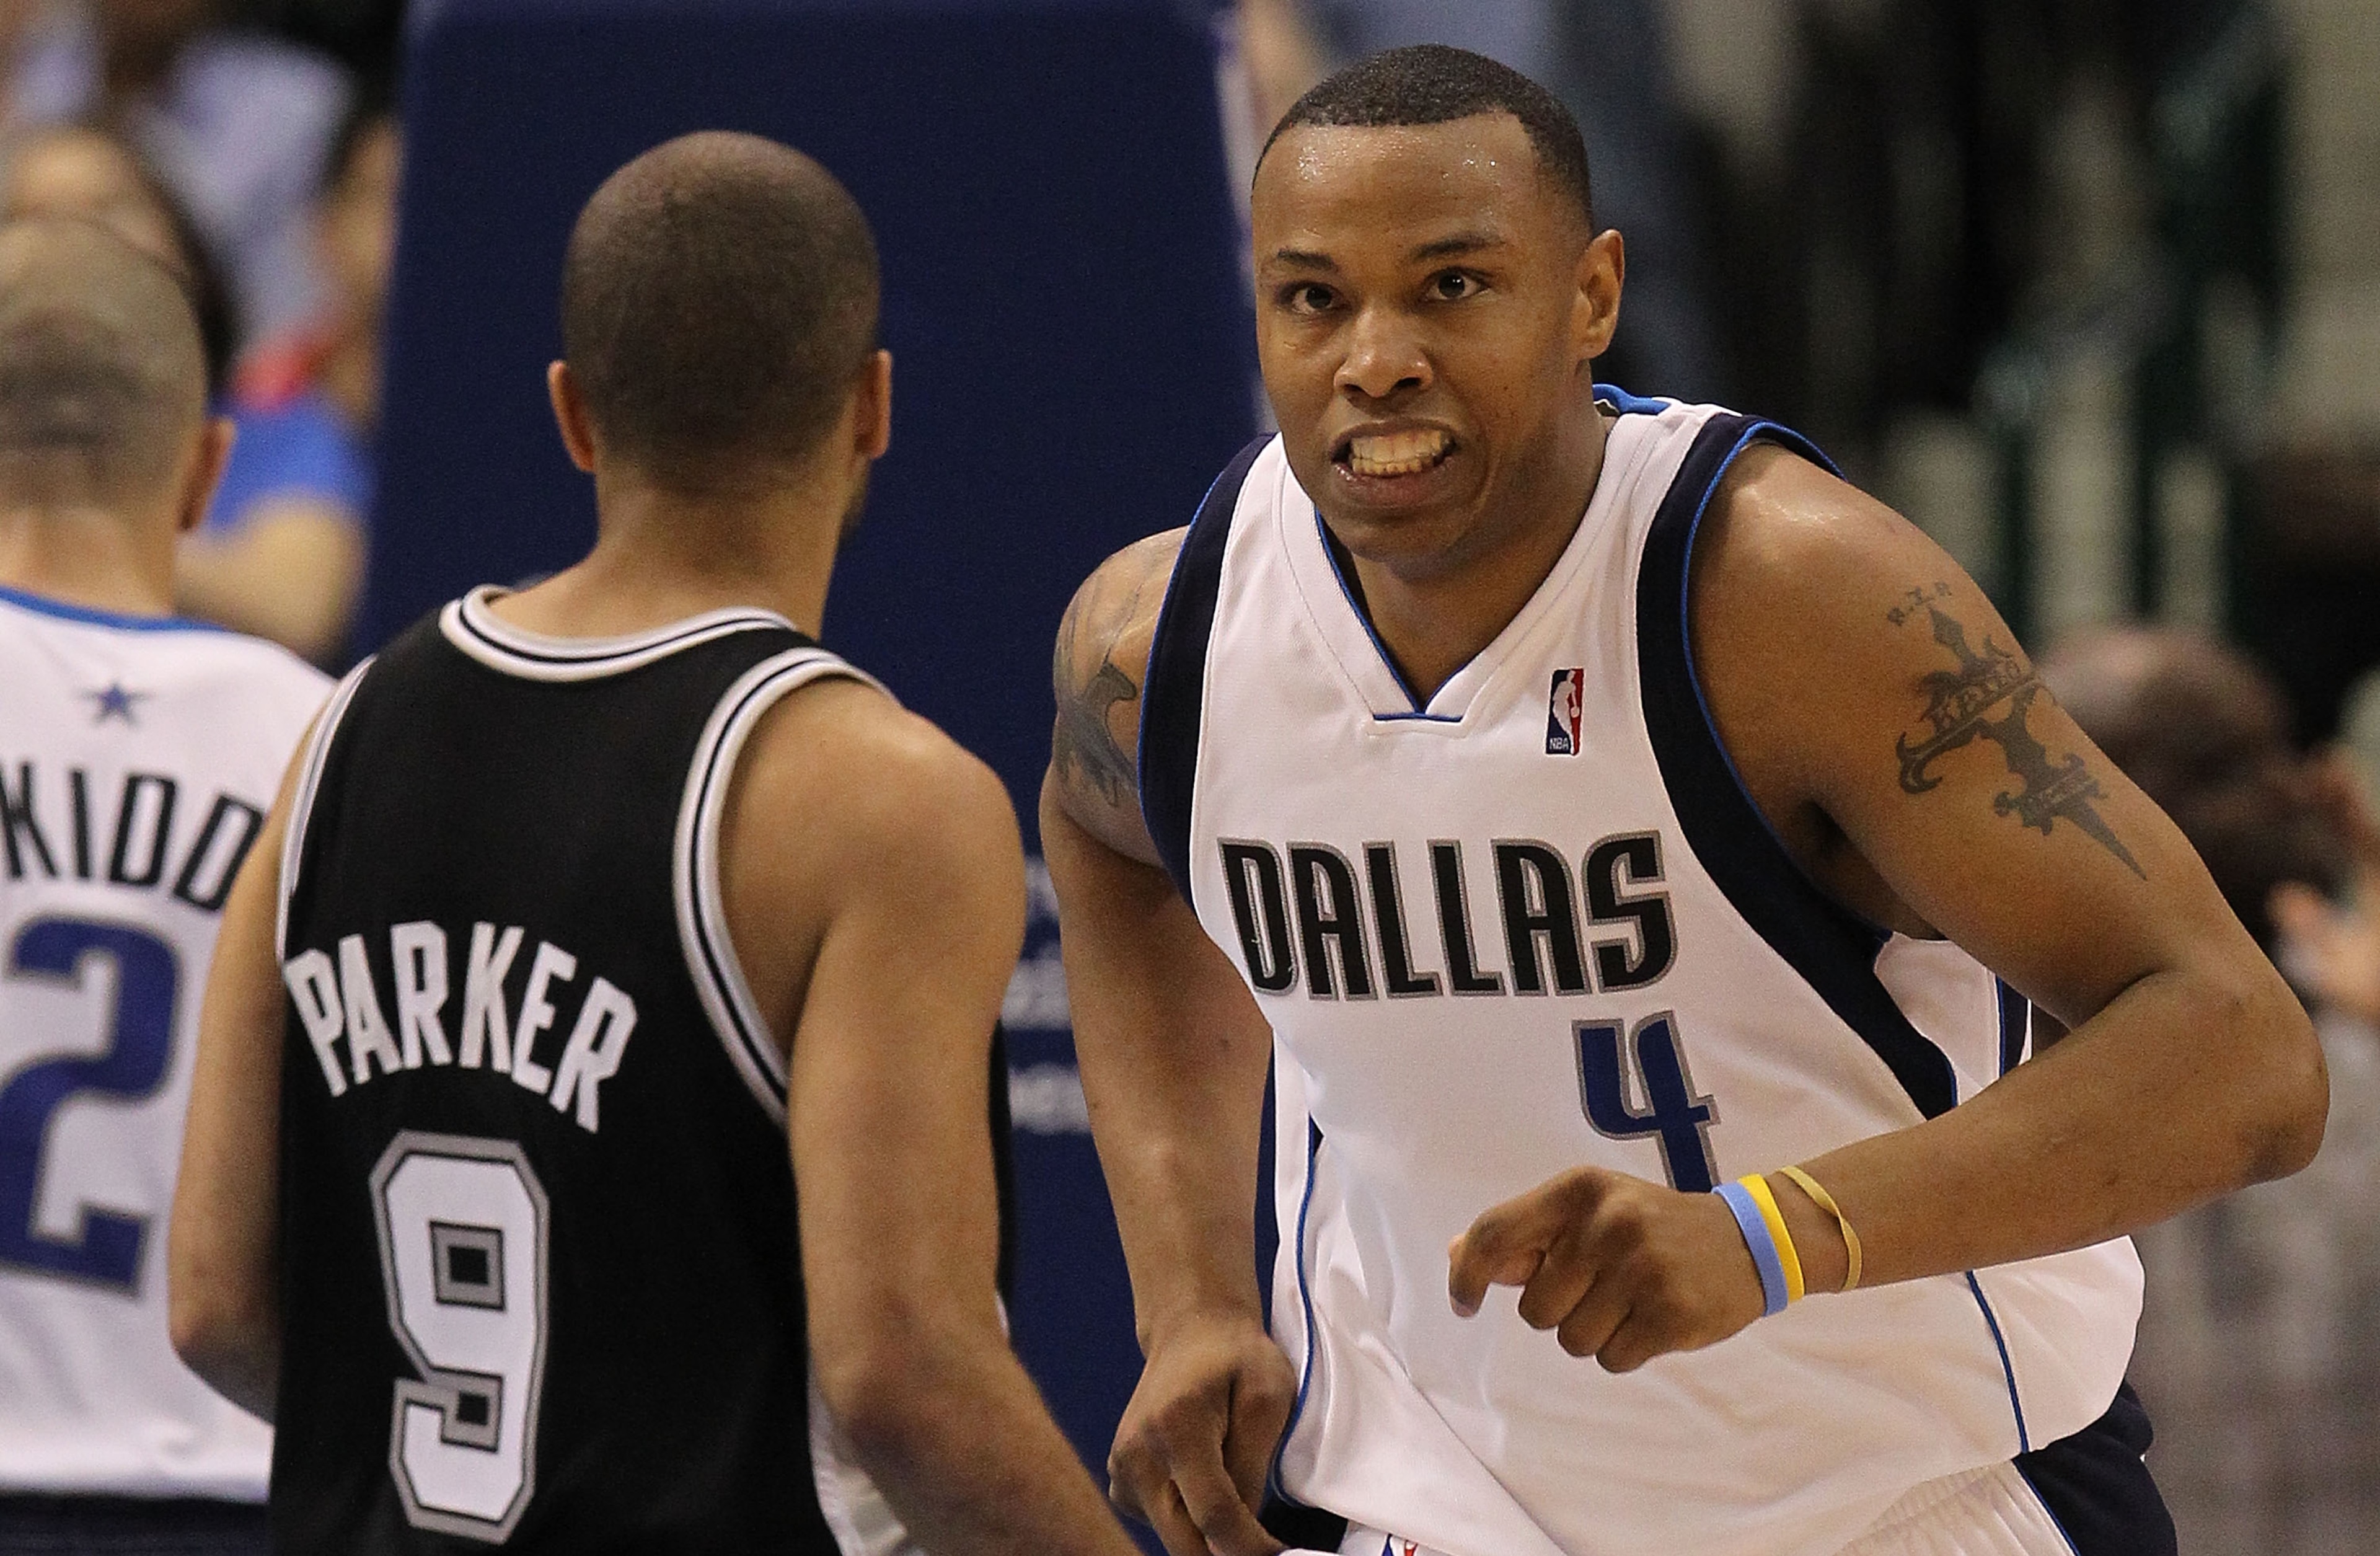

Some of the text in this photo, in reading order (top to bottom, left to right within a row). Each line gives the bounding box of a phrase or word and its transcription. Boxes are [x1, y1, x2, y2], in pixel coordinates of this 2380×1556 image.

[1549, 736, 1569, 751] NBA
[0, 761, 265, 912] KIDD
[1216, 829, 1679, 1001] DALLAS
[0, 908, 185, 1306] 2
[281, 919, 638, 1134] PARKER
[1571, 1010, 1721, 1194] 4
[368, 1128, 551, 1545] 9
